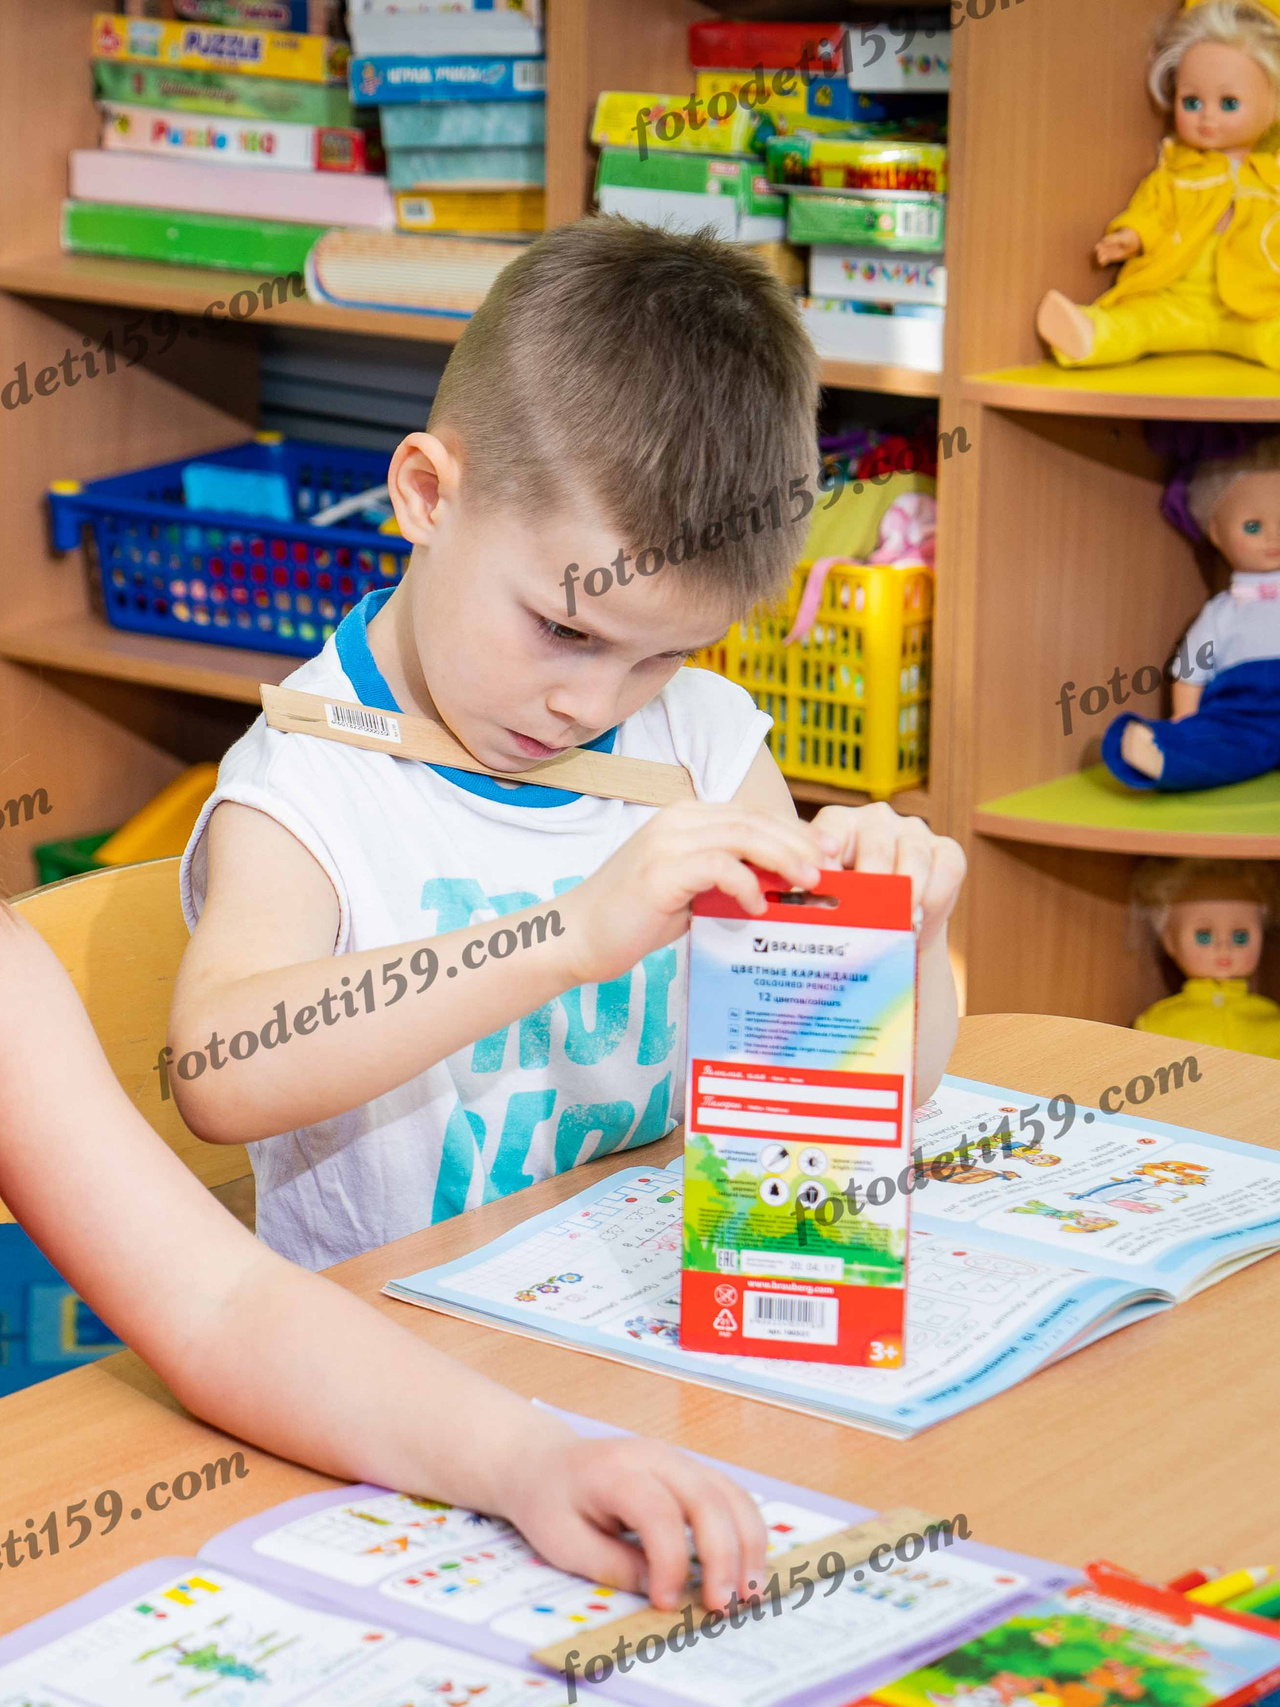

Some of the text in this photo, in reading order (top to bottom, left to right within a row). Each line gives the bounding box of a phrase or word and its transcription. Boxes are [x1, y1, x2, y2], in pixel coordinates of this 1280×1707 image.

[771, 941, 846, 957] BRAUBERG
[731, 964, 868, 982] ЦВЕТНЫЕ КАРАНДАШИ
[753, 978, 846, 992] COLOURED PENCILS
[758, 992, 771, 1002] 12
[747, 1280, 835, 1294] www.brauberg.com
[870, 1341, 898, 1361] 3+
